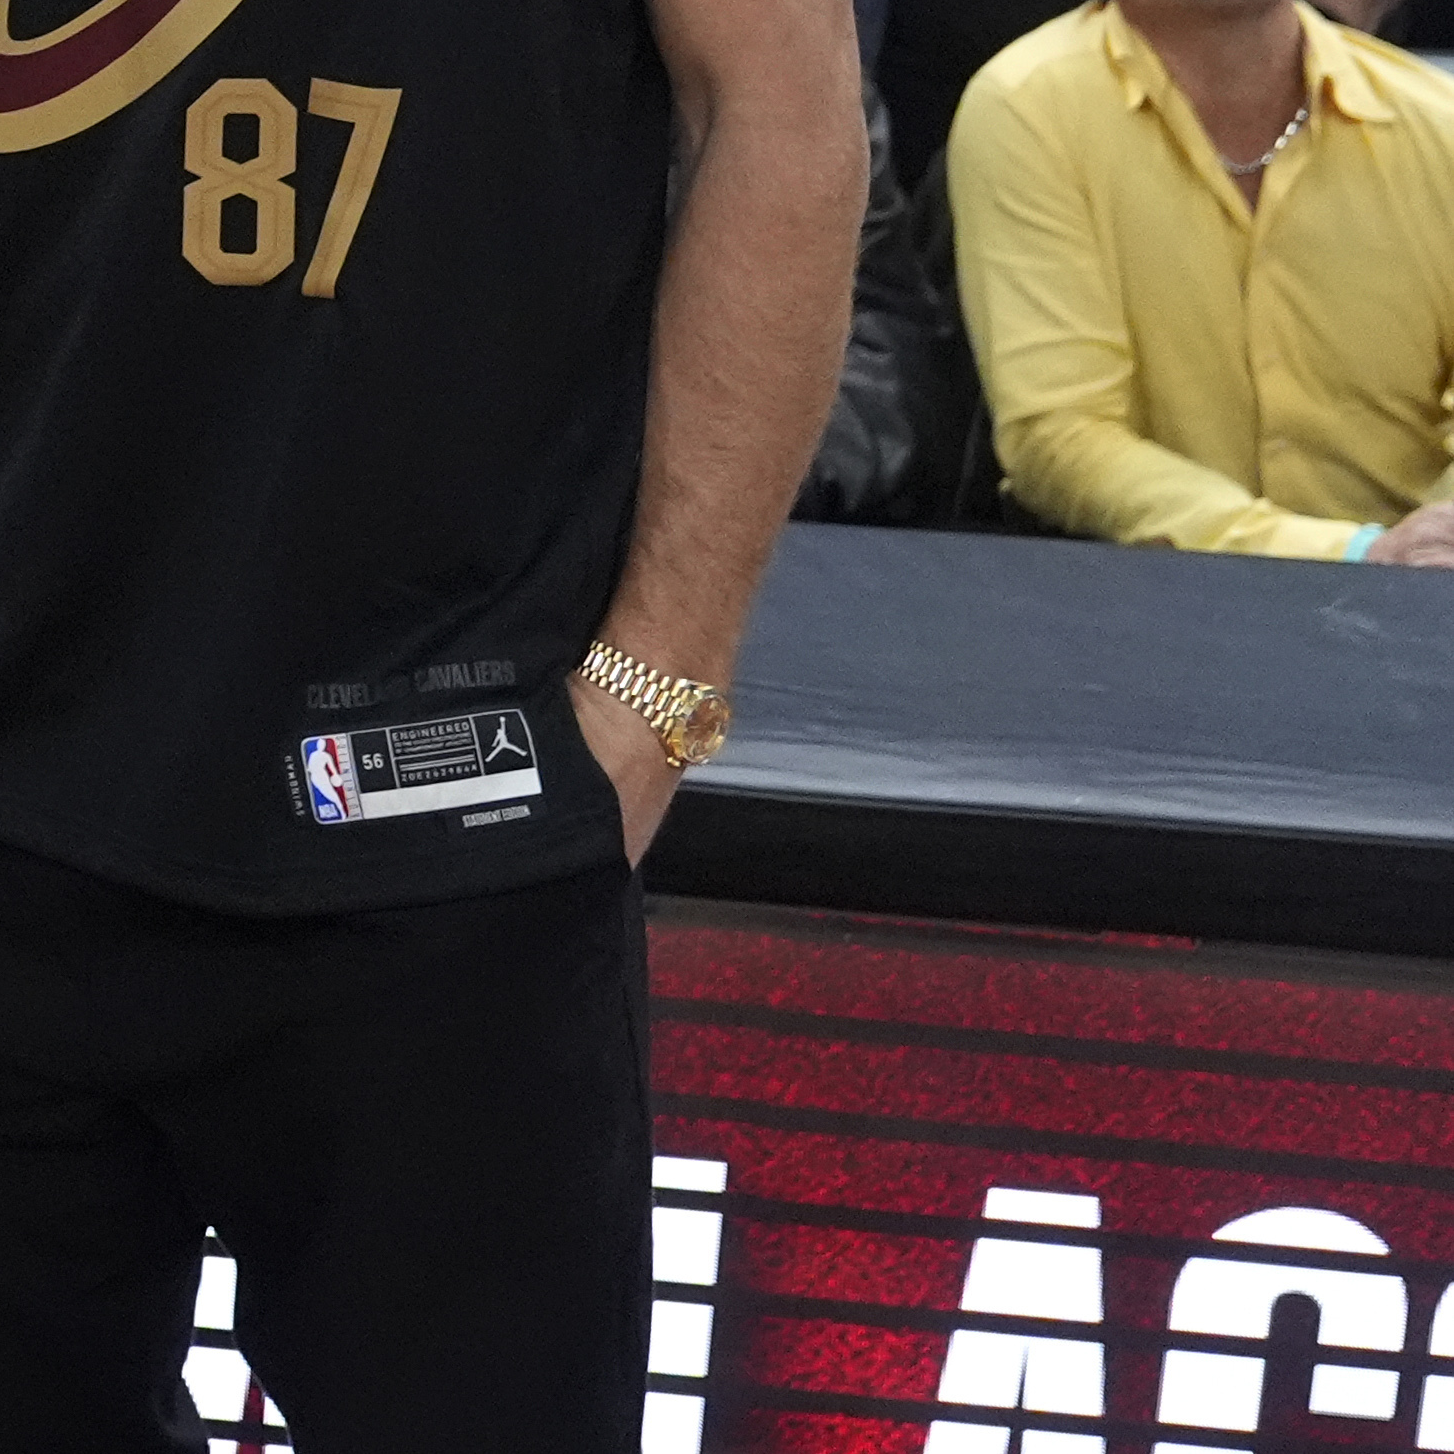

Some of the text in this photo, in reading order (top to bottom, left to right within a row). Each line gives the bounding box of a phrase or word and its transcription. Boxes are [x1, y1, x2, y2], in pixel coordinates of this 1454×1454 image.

[182, 78, 402, 299] 87
[414, 660, 516, 693] CAVALIERS
[392, 721, 470, 742] ENGINEERED
[361, 752, 385, 771] 56
[284, 754, 306, 817] SWINGMAN
